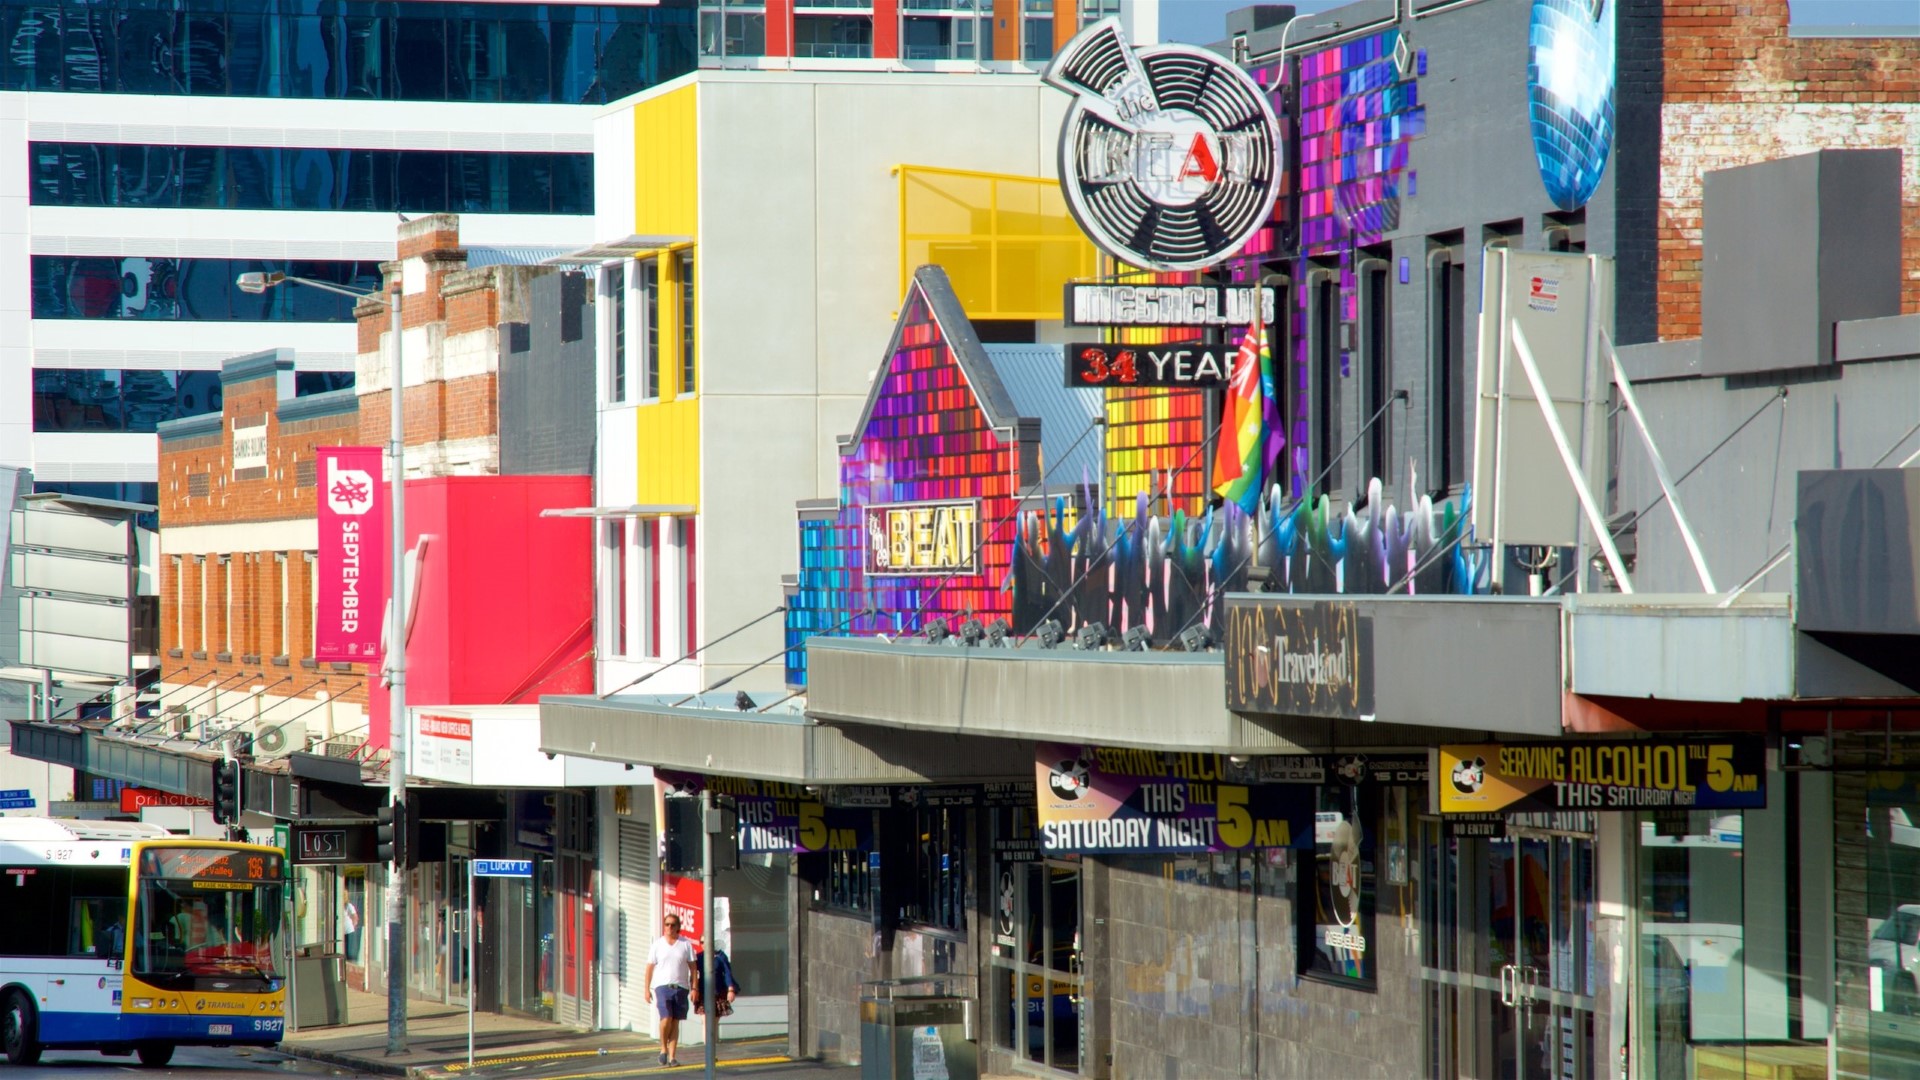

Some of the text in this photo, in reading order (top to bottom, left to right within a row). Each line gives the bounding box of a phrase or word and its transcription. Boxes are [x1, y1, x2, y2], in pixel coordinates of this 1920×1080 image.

[1116, 95, 1155, 121] the
[1080, 348, 1138, 383] 34
[886, 506, 976, 570] BEAT
[342, 521, 360, 634] SEPTEMBER
[1275, 635, 1347, 685] Traveland
[1097, 748, 1167, 777] SERVING
[1500, 744, 1758, 793] SERVING ALCOHOL TILL 5 AM
[1140, 783, 1185, 813] THIS
[1553, 782, 1697, 807] THIS SATURDAY NIGHT
[738, 801, 773, 824] THIS
[776, 801, 858, 851] TILL 5 AM
[1187, 783, 1291, 849] TILL 5 AM
[303, 833, 341, 852] LOST
[751, 827, 799, 850] NIGHT
[1044, 817, 1216, 849] SATURDAY NIGHT
[1453, 823, 1466, 835] NO
[1467, 823, 1496, 836] ENTRY
[490, 861, 515, 871] LUCKY
[1013, 851, 1036, 861] ENTRY
[254, 1020, 283, 1031] S1927
